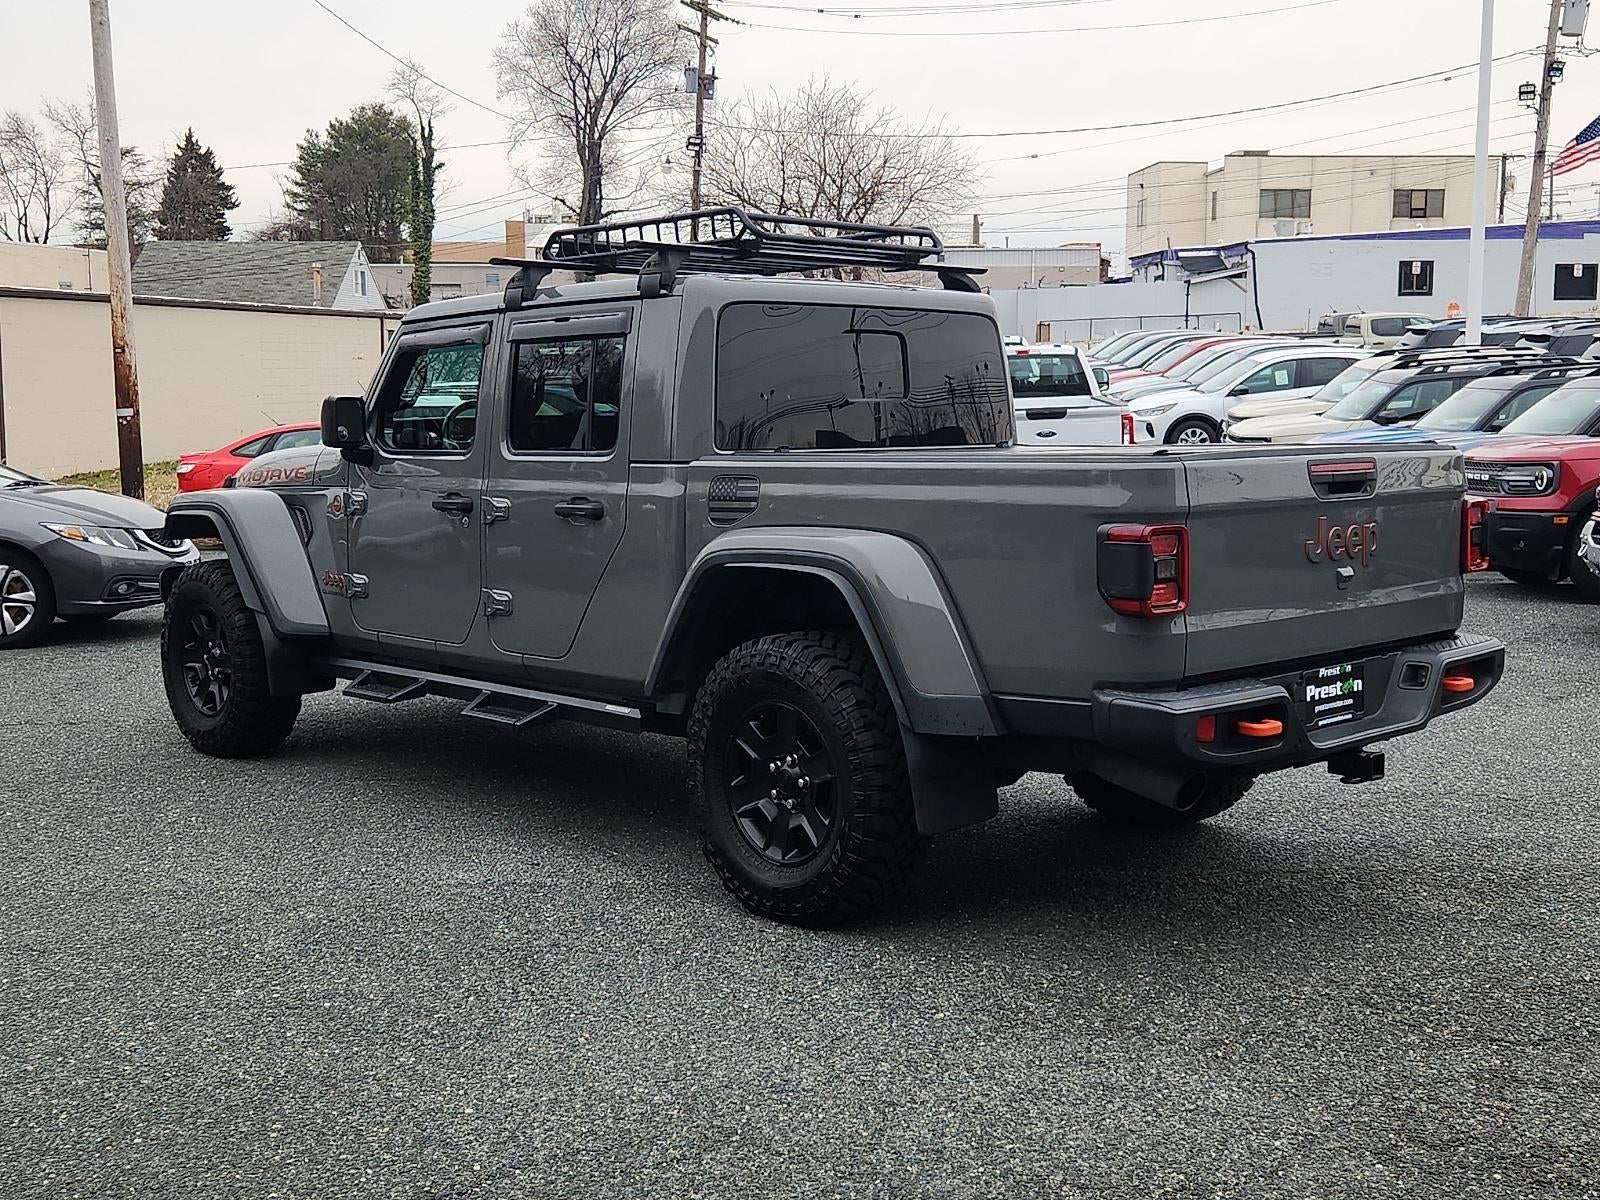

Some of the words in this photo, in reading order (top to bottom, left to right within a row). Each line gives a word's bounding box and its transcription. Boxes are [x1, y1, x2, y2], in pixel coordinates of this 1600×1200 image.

[237, 466, 308, 484] MOJAVE
[1305, 515, 1377, 567] Jeep
[322, 570, 344, 589] Jeep
[1319, 663, 1351, 678] Preston
[1306, 678, 1362, 702] Preston
